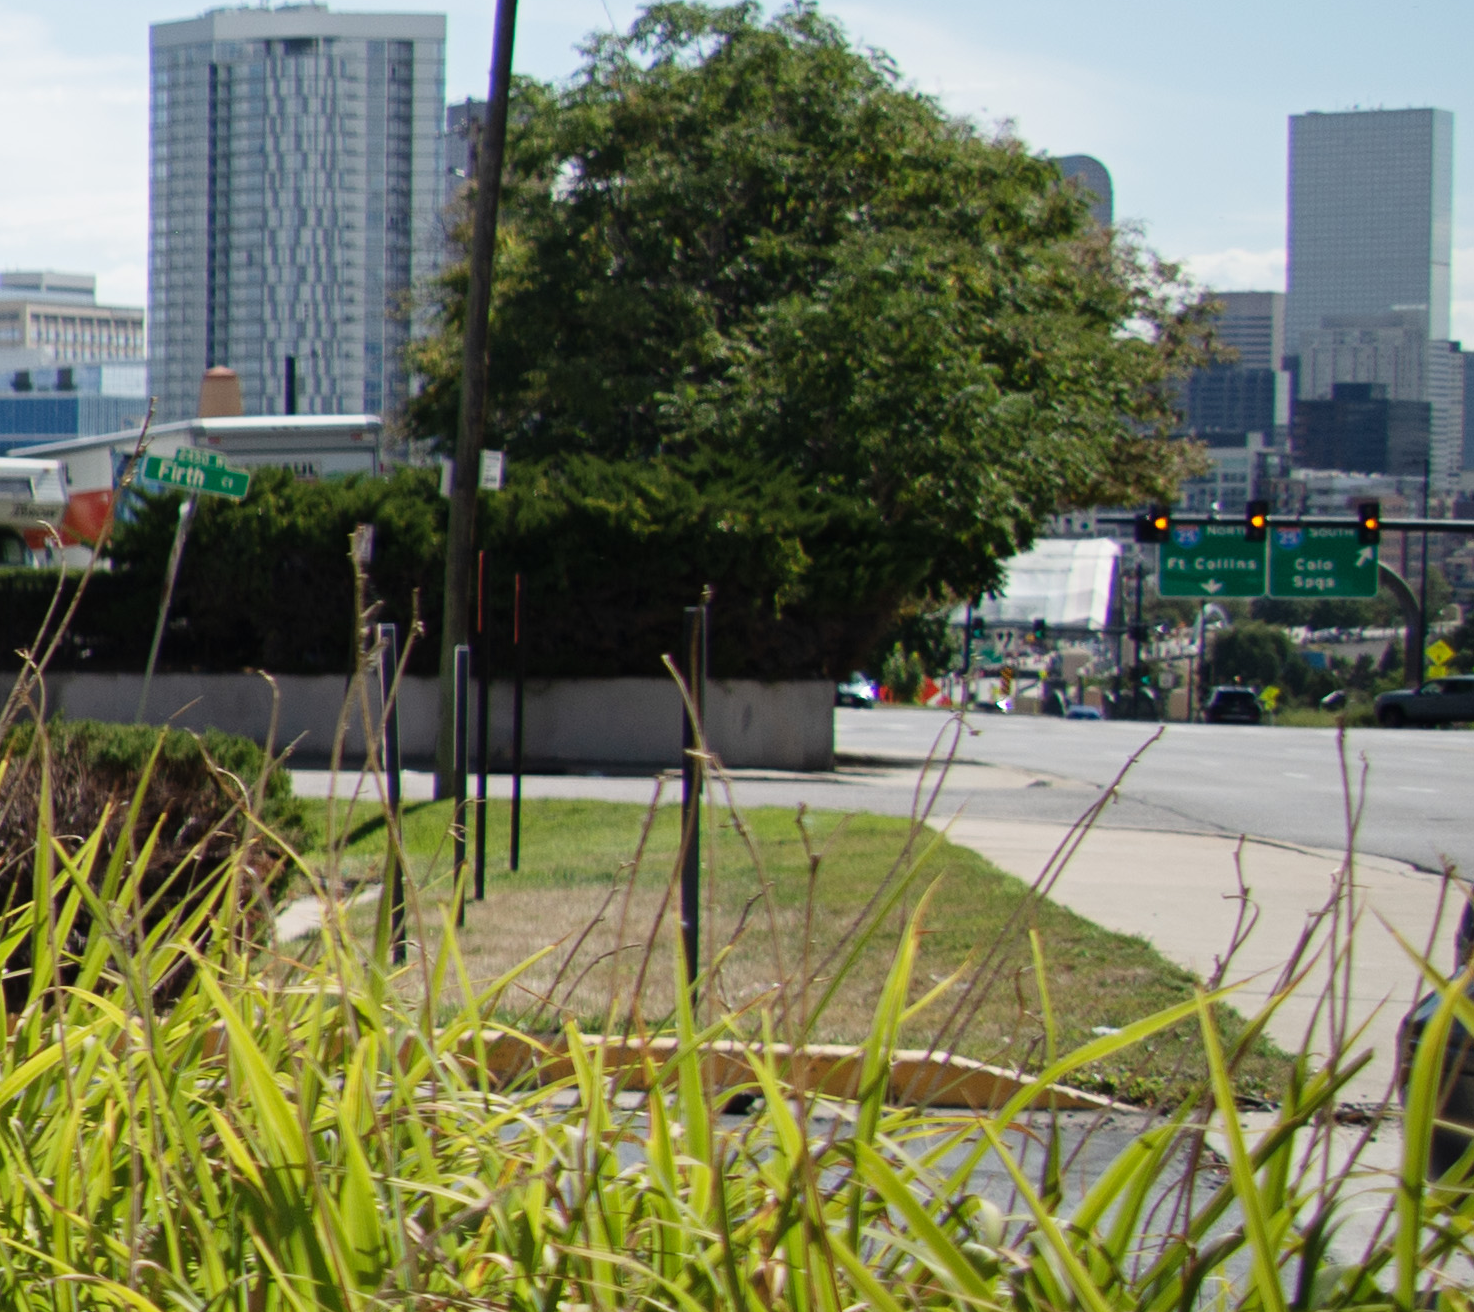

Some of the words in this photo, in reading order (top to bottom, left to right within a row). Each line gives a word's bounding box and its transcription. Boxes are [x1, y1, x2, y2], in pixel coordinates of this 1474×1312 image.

[158, 458, 205, 488] Firth
[1167, 557, 1185, 570] Ft
[1195, 557, 1257, 570] Collins
[1295, 558, 1333, 571] Colo
